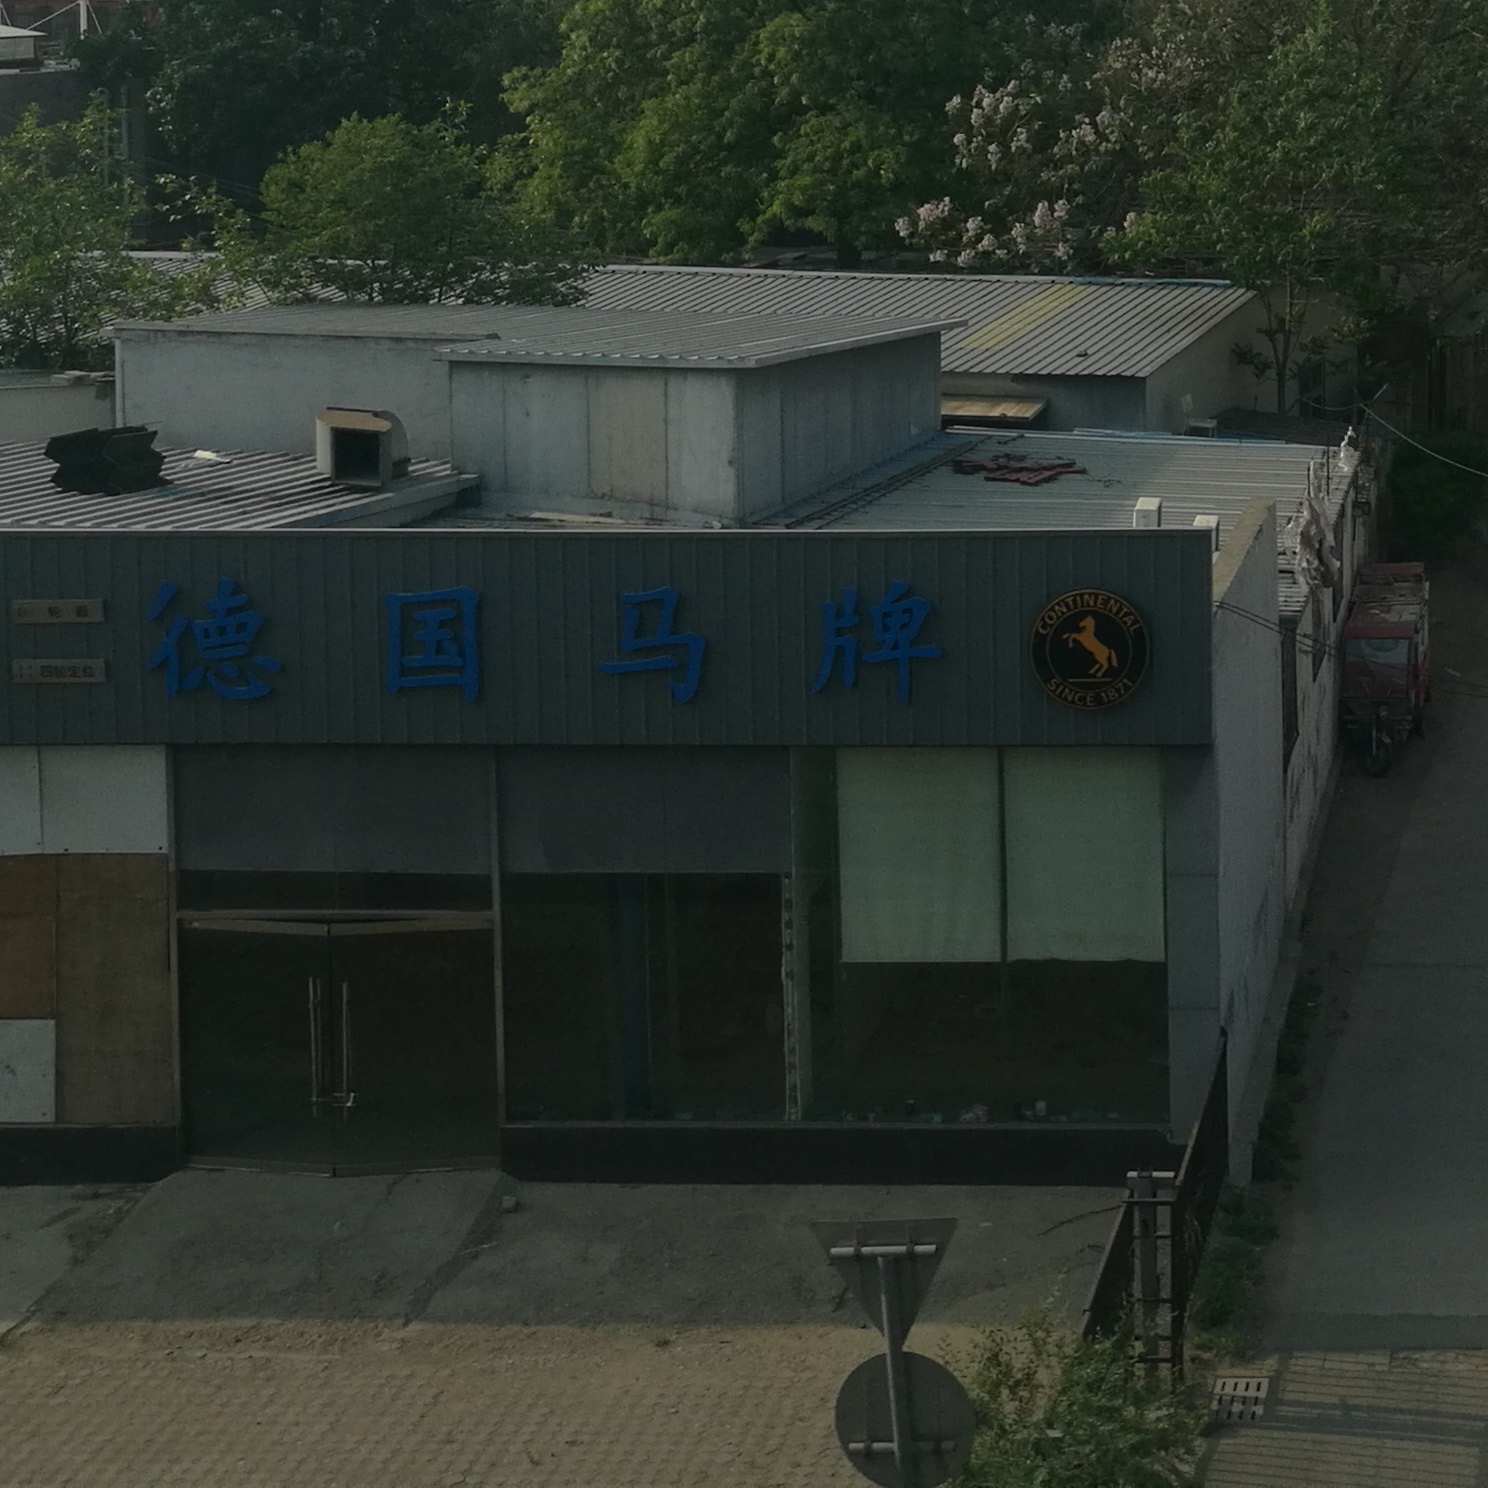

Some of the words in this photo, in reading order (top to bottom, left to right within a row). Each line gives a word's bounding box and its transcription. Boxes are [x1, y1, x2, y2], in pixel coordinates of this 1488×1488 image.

[1038, 594, 1141, 635] CONTINENTAL
[148, 576, 942, 703] 德国马牌
[39, 664, 96, 679] 四轮定位
[1047, 678, 1097, 706] SINCE
[1101, 678, 1133, 703] 1871
